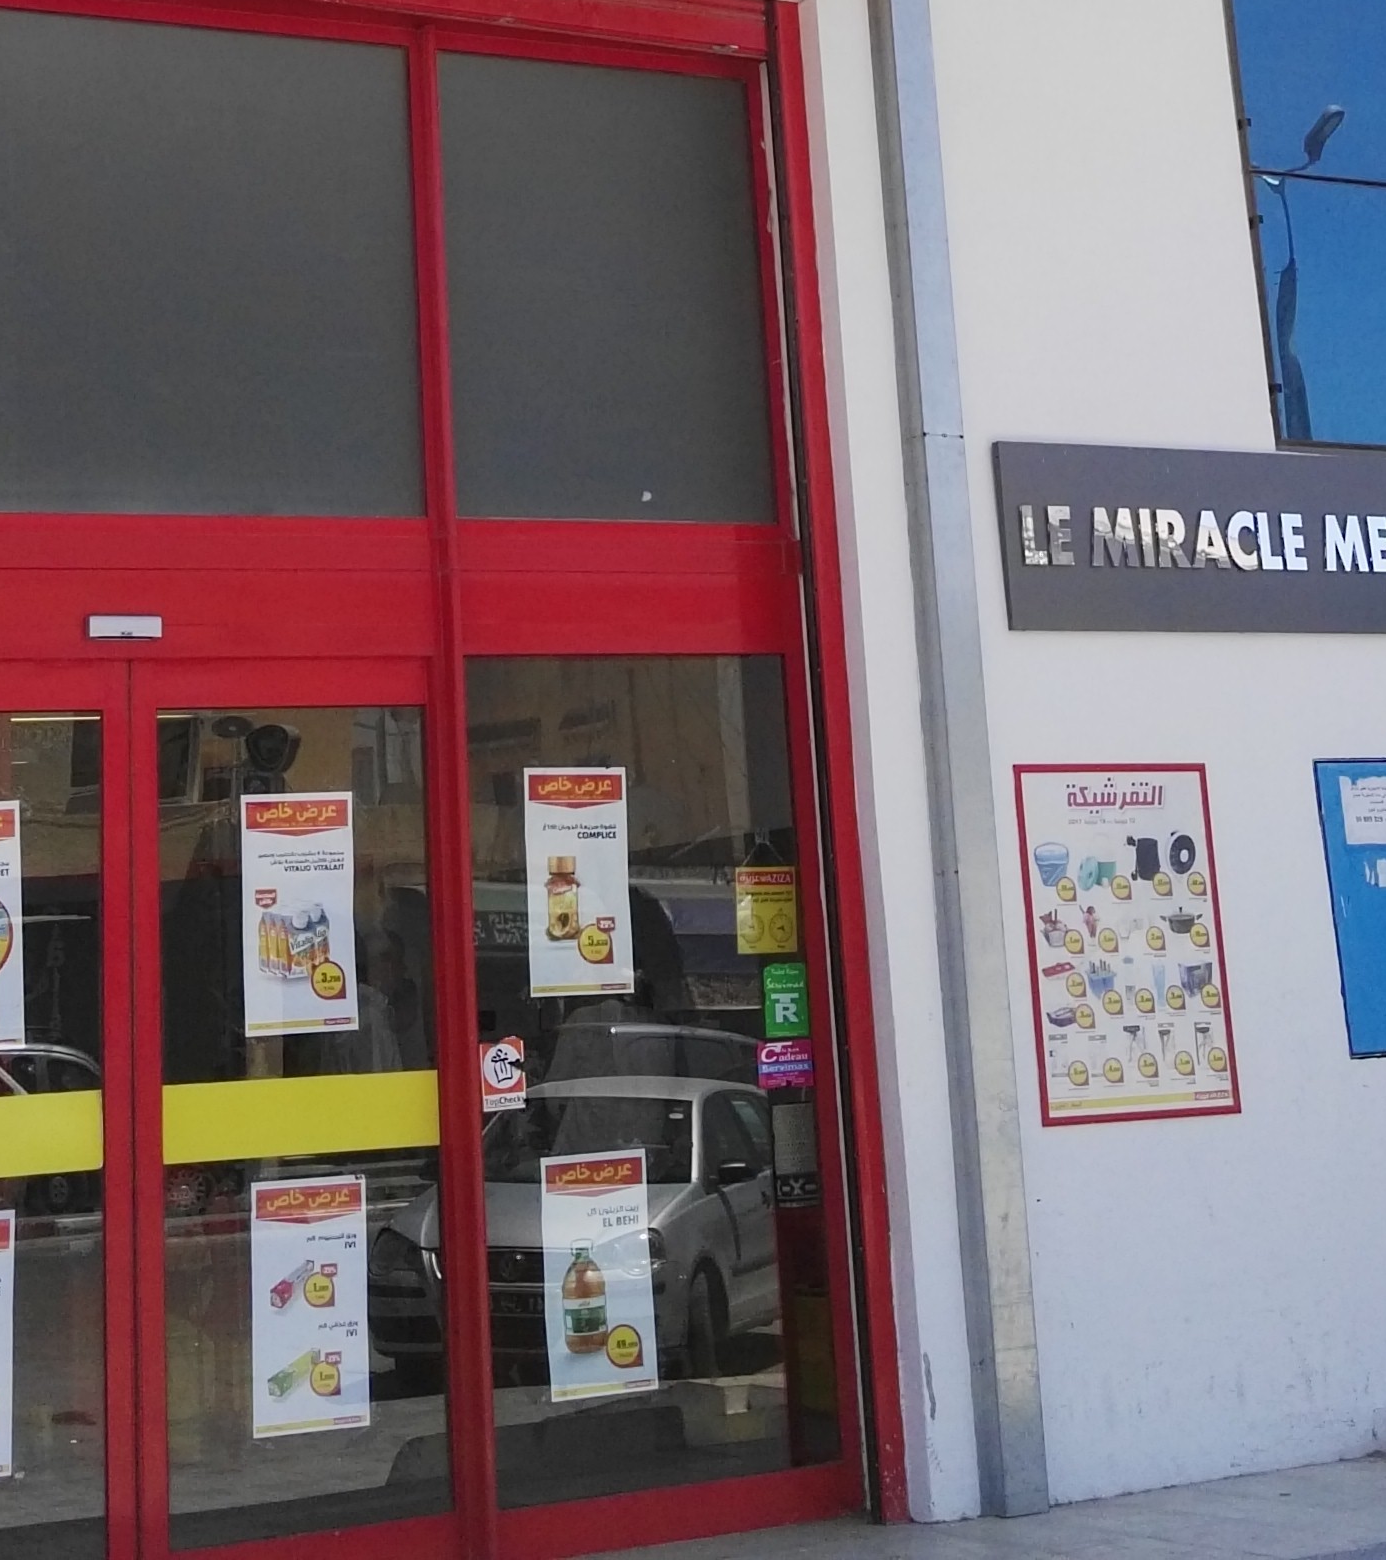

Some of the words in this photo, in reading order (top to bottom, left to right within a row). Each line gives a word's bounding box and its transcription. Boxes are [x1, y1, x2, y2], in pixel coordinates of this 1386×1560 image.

[1018, 504, 1075, 567] LE
[1090, 505, 1309, 571] MIRACLE
[538, 776, 572, 795] خاص
[575, 778, 612, 794] عرض
[256, 803, 293, 822] خاص
[296, 804, 337, 821] عرض
[577, 831, 617, 839] COMPLICE
[766, 873, 792, 883] AZIZA
[555, 1164, 591, 1185] خاص
[594, 1163, 632, 1181] عرض
[266, 1189, 305, 1211] خاص
[309, 1189, 350, 1207] عرض
[603, 1218, 613, 1228] EL
[616, 1215, 639, 1227] BEHI
